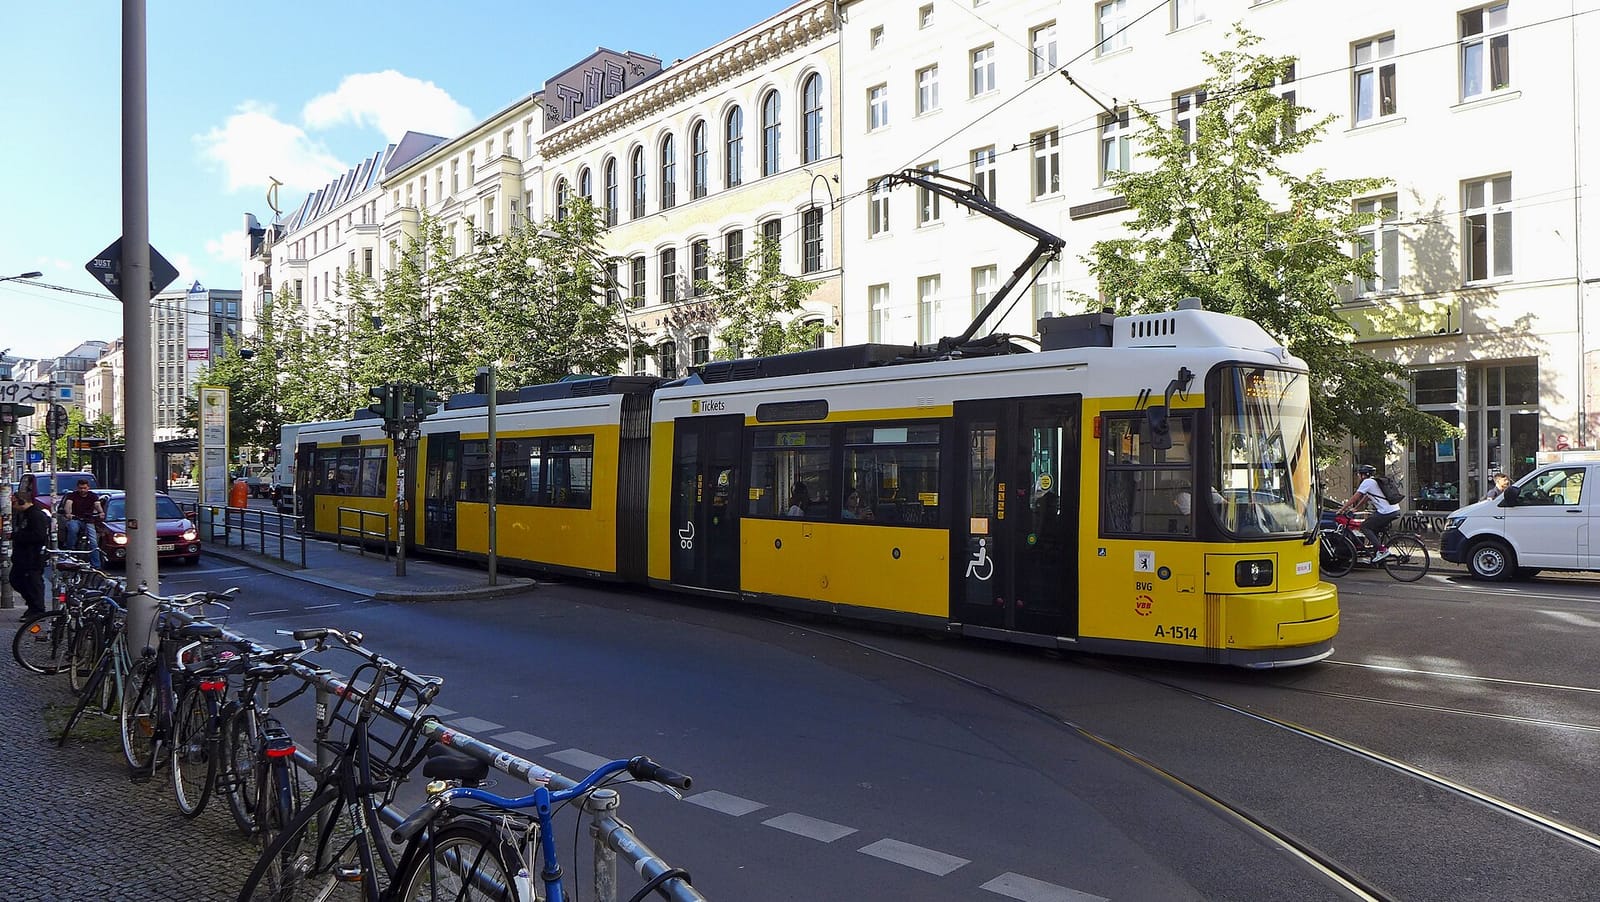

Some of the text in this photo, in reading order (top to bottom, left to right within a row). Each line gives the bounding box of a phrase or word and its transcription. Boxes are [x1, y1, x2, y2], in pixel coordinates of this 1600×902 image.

[701, 400, 725, 411] Tickets
[1136, 582, 1153, 591] BVG
[1155, 624, 1198, 640] A-1514
